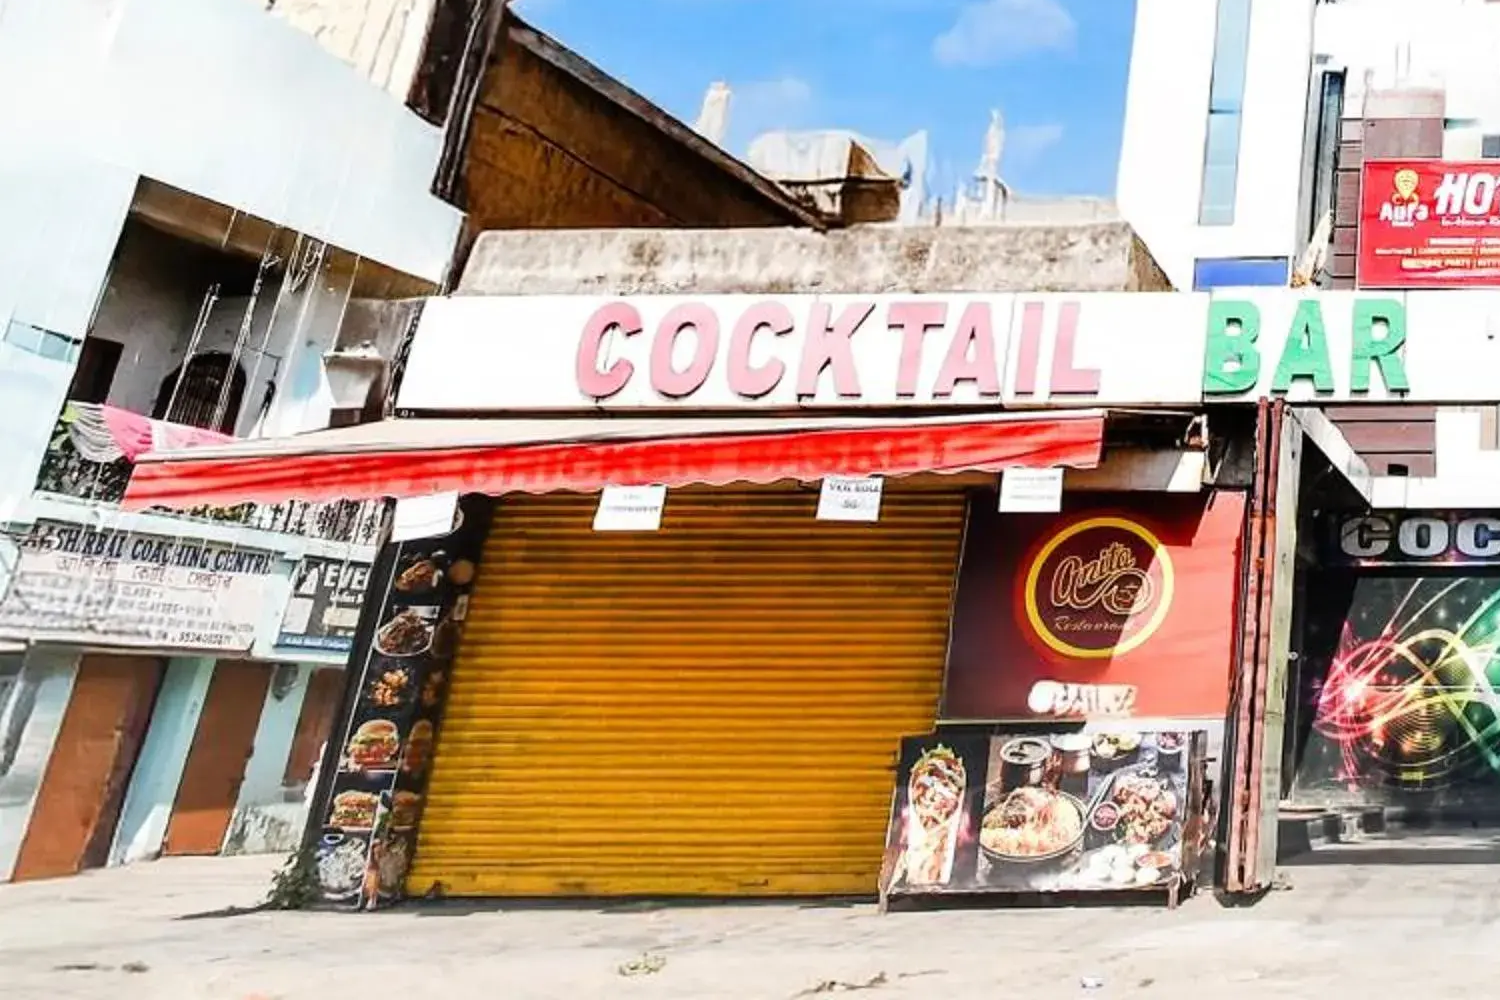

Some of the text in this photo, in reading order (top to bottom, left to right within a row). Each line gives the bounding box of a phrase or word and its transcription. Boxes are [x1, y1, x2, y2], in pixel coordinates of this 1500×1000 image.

[575, 298, 1410, 397] COCKTAIL BAR
[131, 539, 212, 569] COACHING
